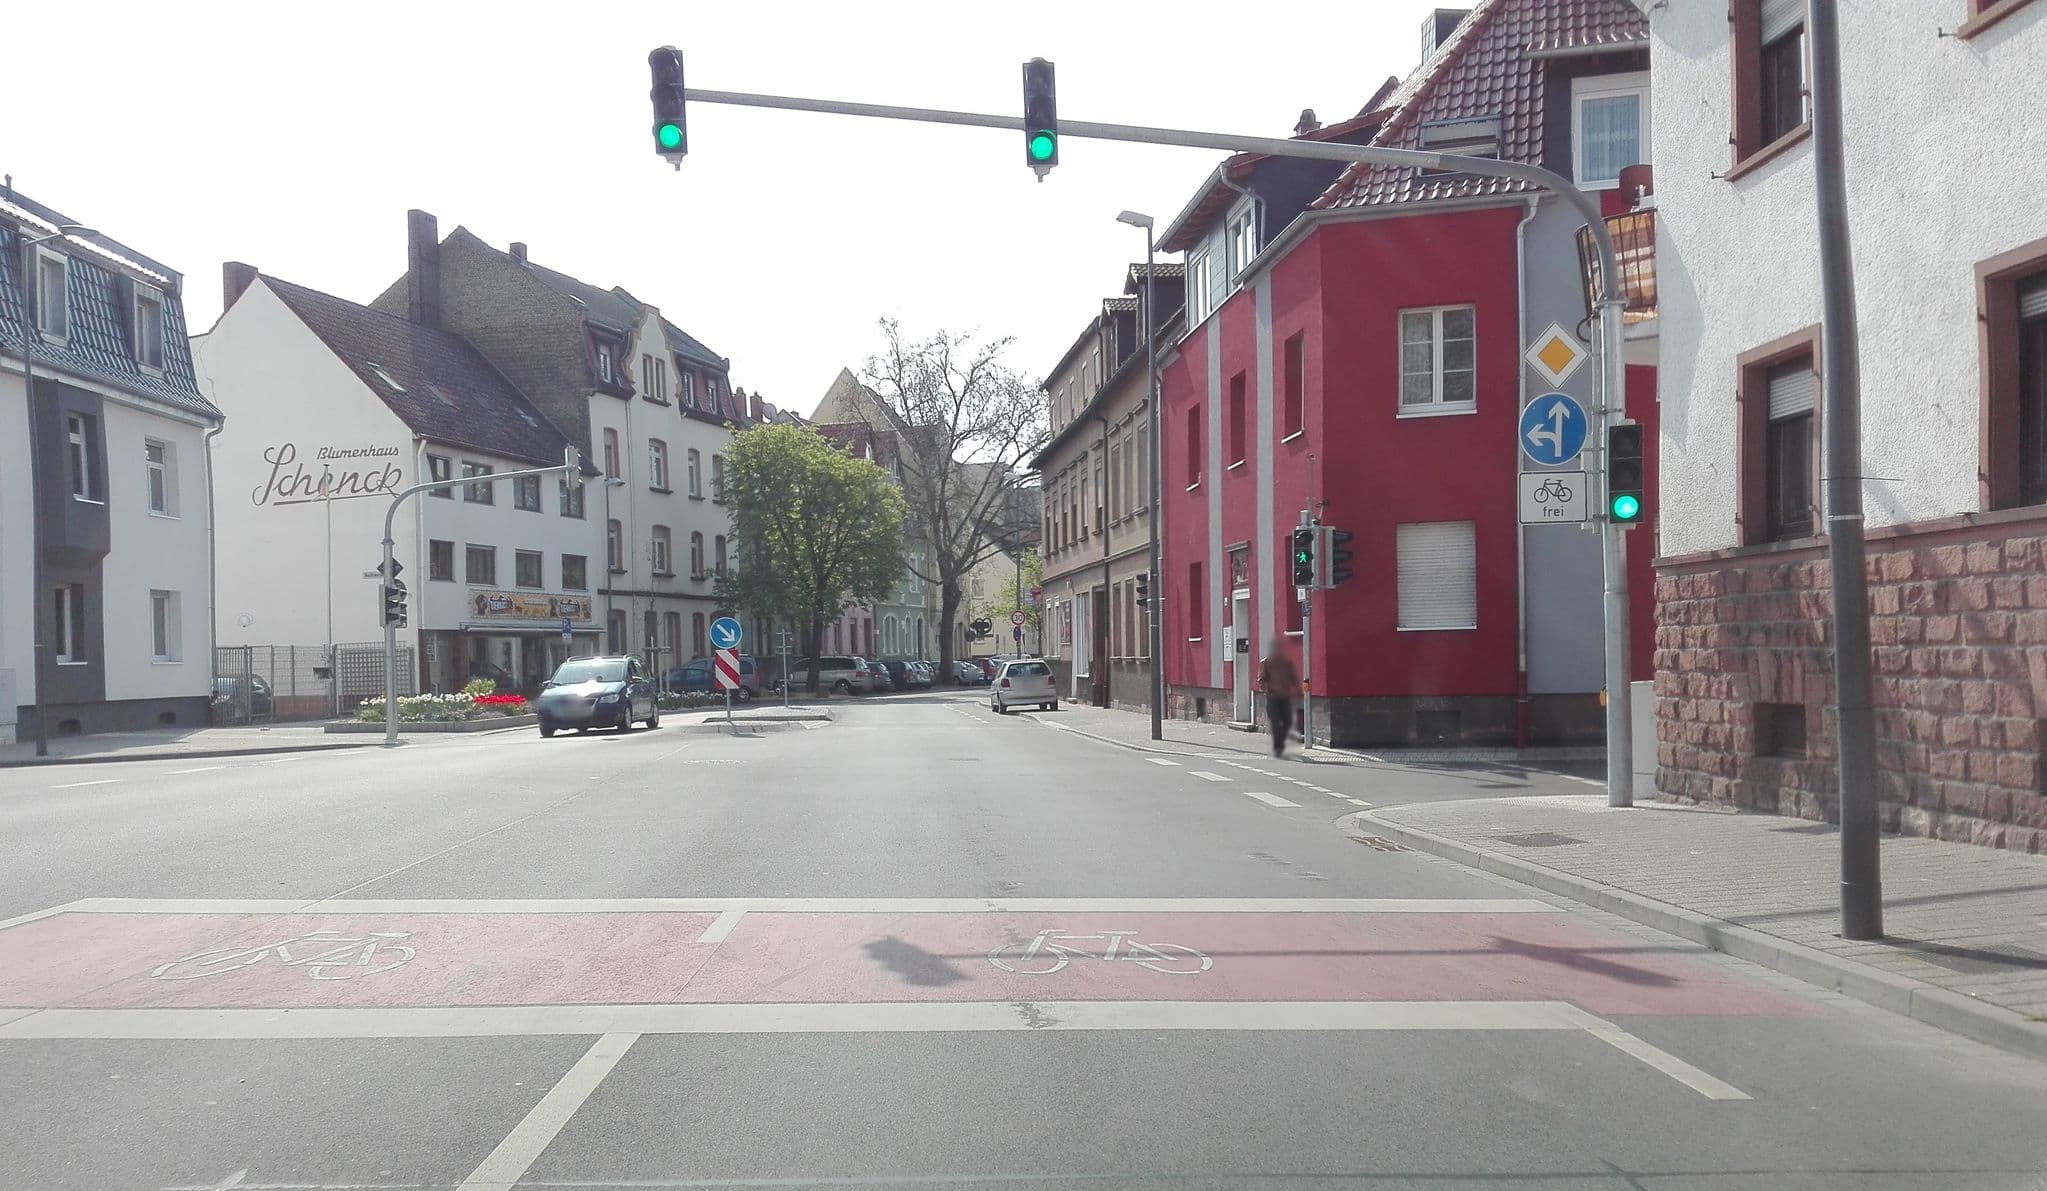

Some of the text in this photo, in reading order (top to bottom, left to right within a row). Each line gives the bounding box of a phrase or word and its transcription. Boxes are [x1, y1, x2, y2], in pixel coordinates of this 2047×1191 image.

[317, 444, 399, 460] Blumenhaus
[252, 442, 402, 506] Schenck
[1543, 505, 1564, 517] frei
[1014, 614, 1023, 622] 30
